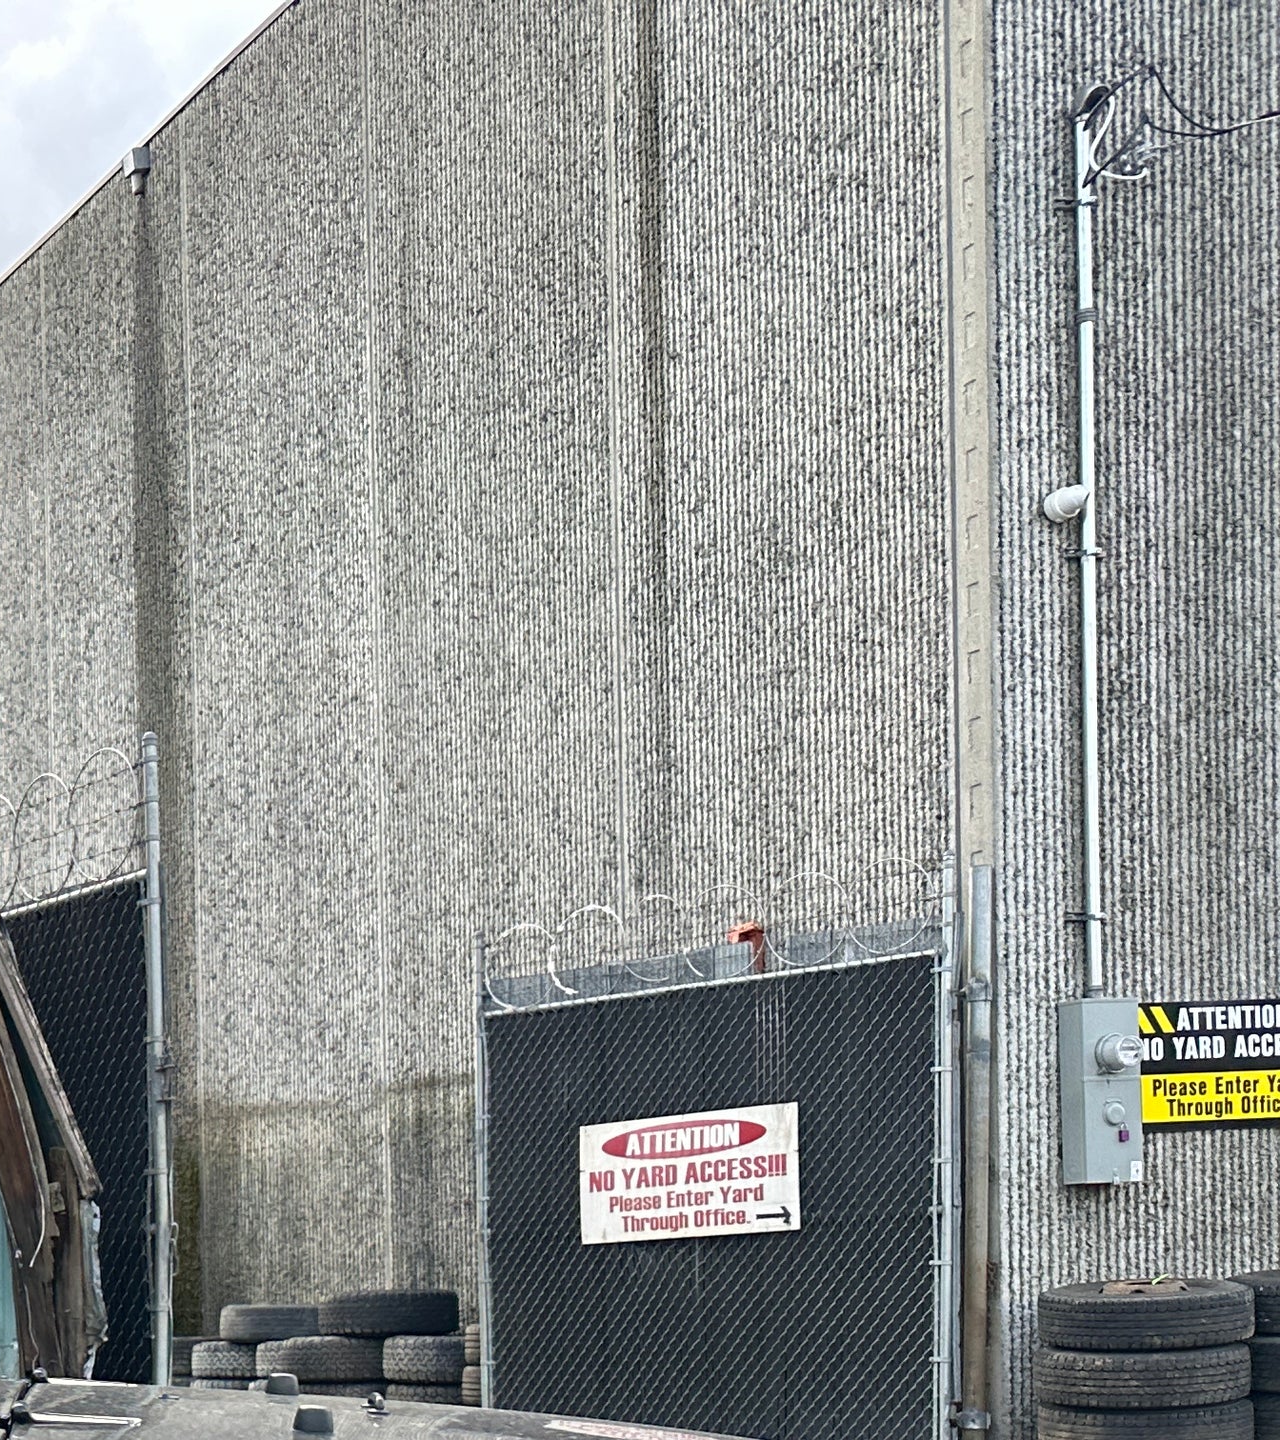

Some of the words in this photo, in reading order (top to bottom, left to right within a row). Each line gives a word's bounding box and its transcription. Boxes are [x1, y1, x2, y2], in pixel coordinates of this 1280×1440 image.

[1172, 1035, 1226, 1060] YARD
[1152, 1078, 1207, 1097] Please
[1215, 1076, 1260, 1095] Enter
[1166, 1096, 1233, 1118] Through
[1241, 1094, 1280, 1114] Offic
[625, 1122, 740, 1156] ATTENTION
[589, 1169, 615, 1193] NO
[622, 1164, 678, 1190] YARD
[684, 1153, 787, 1185] ACCESS!!!
[609, 1195, 662, 1213] Please
[666, 1190, 714, 1209] Enter
[719, 1183, 764, 1204] Yard
[621, 1212, 689, 1233] Through
